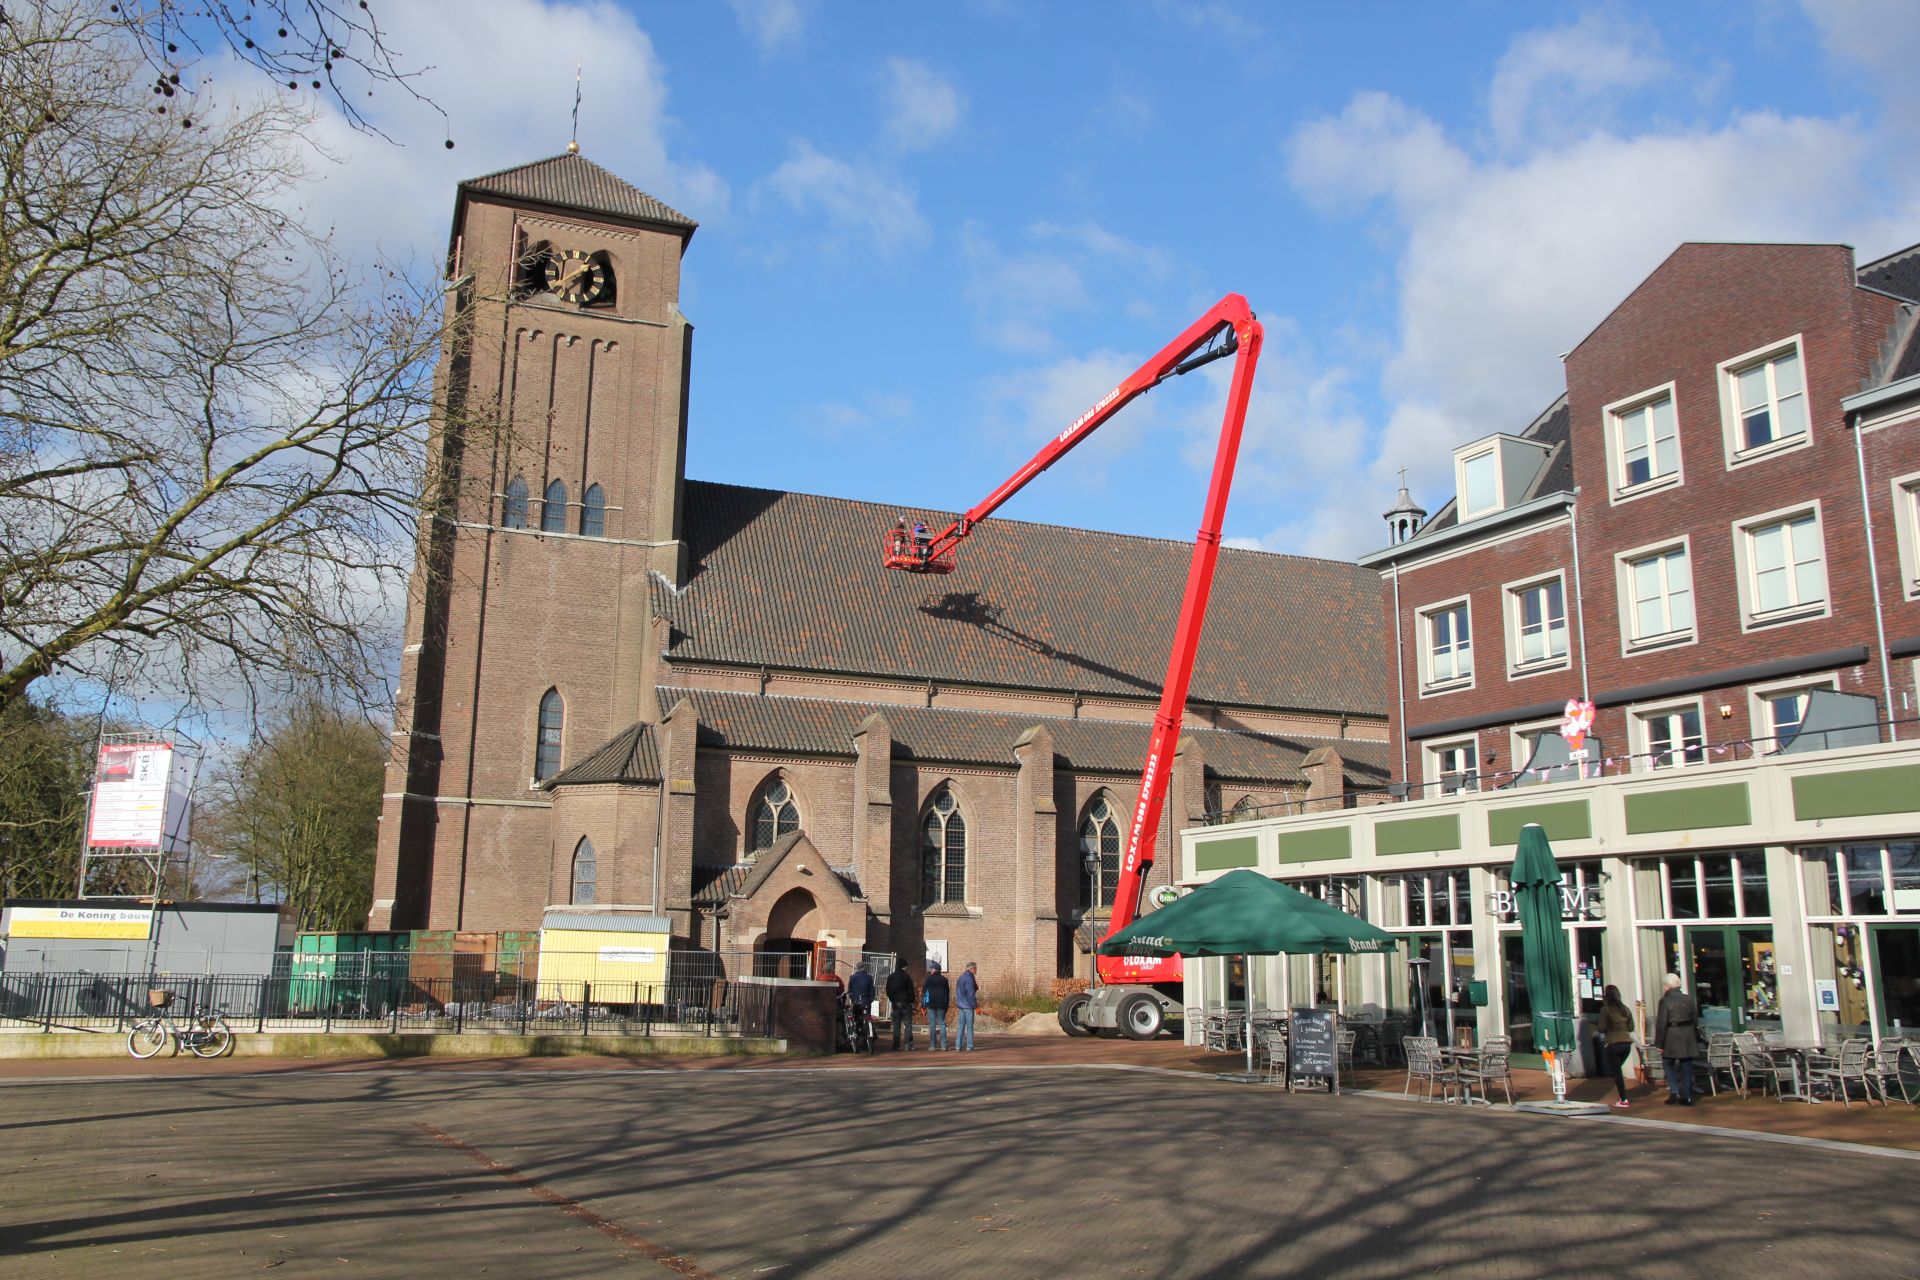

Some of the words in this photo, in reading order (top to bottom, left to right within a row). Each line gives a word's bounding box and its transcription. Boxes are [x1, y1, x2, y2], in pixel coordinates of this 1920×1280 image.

[1060, 416, 1084, 443] LOXAM
[1084, 408, 1095, 422] 088
[1095, 387, 1120, 413] 5702222
[1126, 823, 1142, 872] LOXAM
[1136, 802, 1146, 822] 088
[1142, 754, 1157, 800] 5702222
[78, 911, 116, 921] Koning
[120, 912, 150, 920] bouw
[1349, 937, 1378, 952] Brand
[1130, 956, 1162, 966] LOXAM
